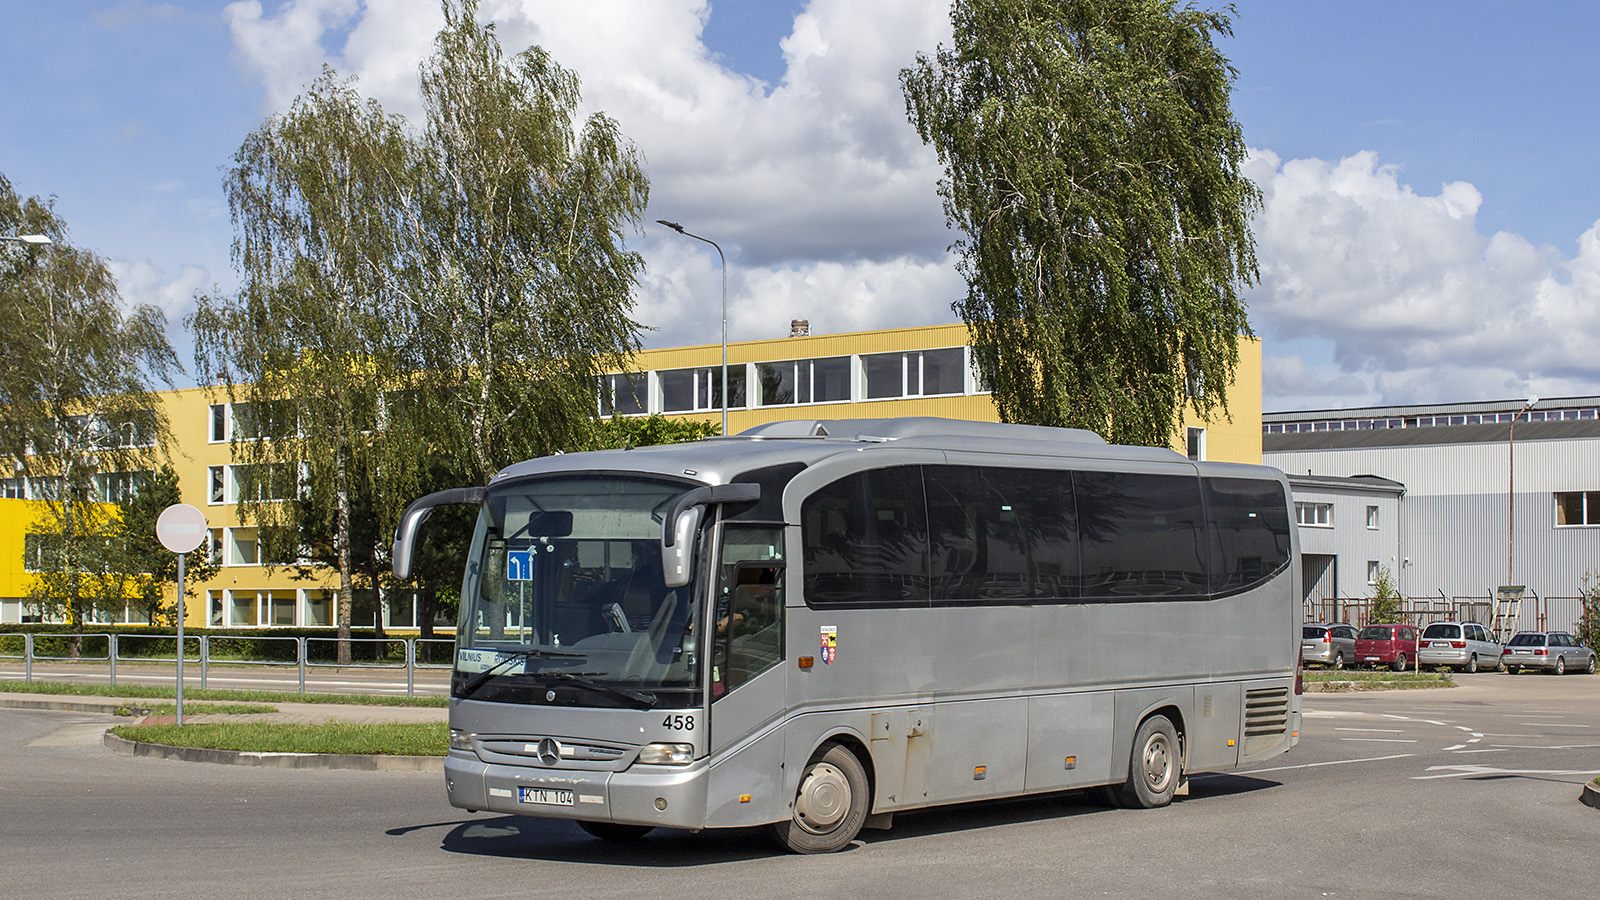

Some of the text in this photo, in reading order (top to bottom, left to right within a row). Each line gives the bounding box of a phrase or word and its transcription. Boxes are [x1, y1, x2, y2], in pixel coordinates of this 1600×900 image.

[459, 652, 482, 662] VILNIUS
[662, 714, 694, 731] 458
[525, 788, 572, 803] KTN 104
